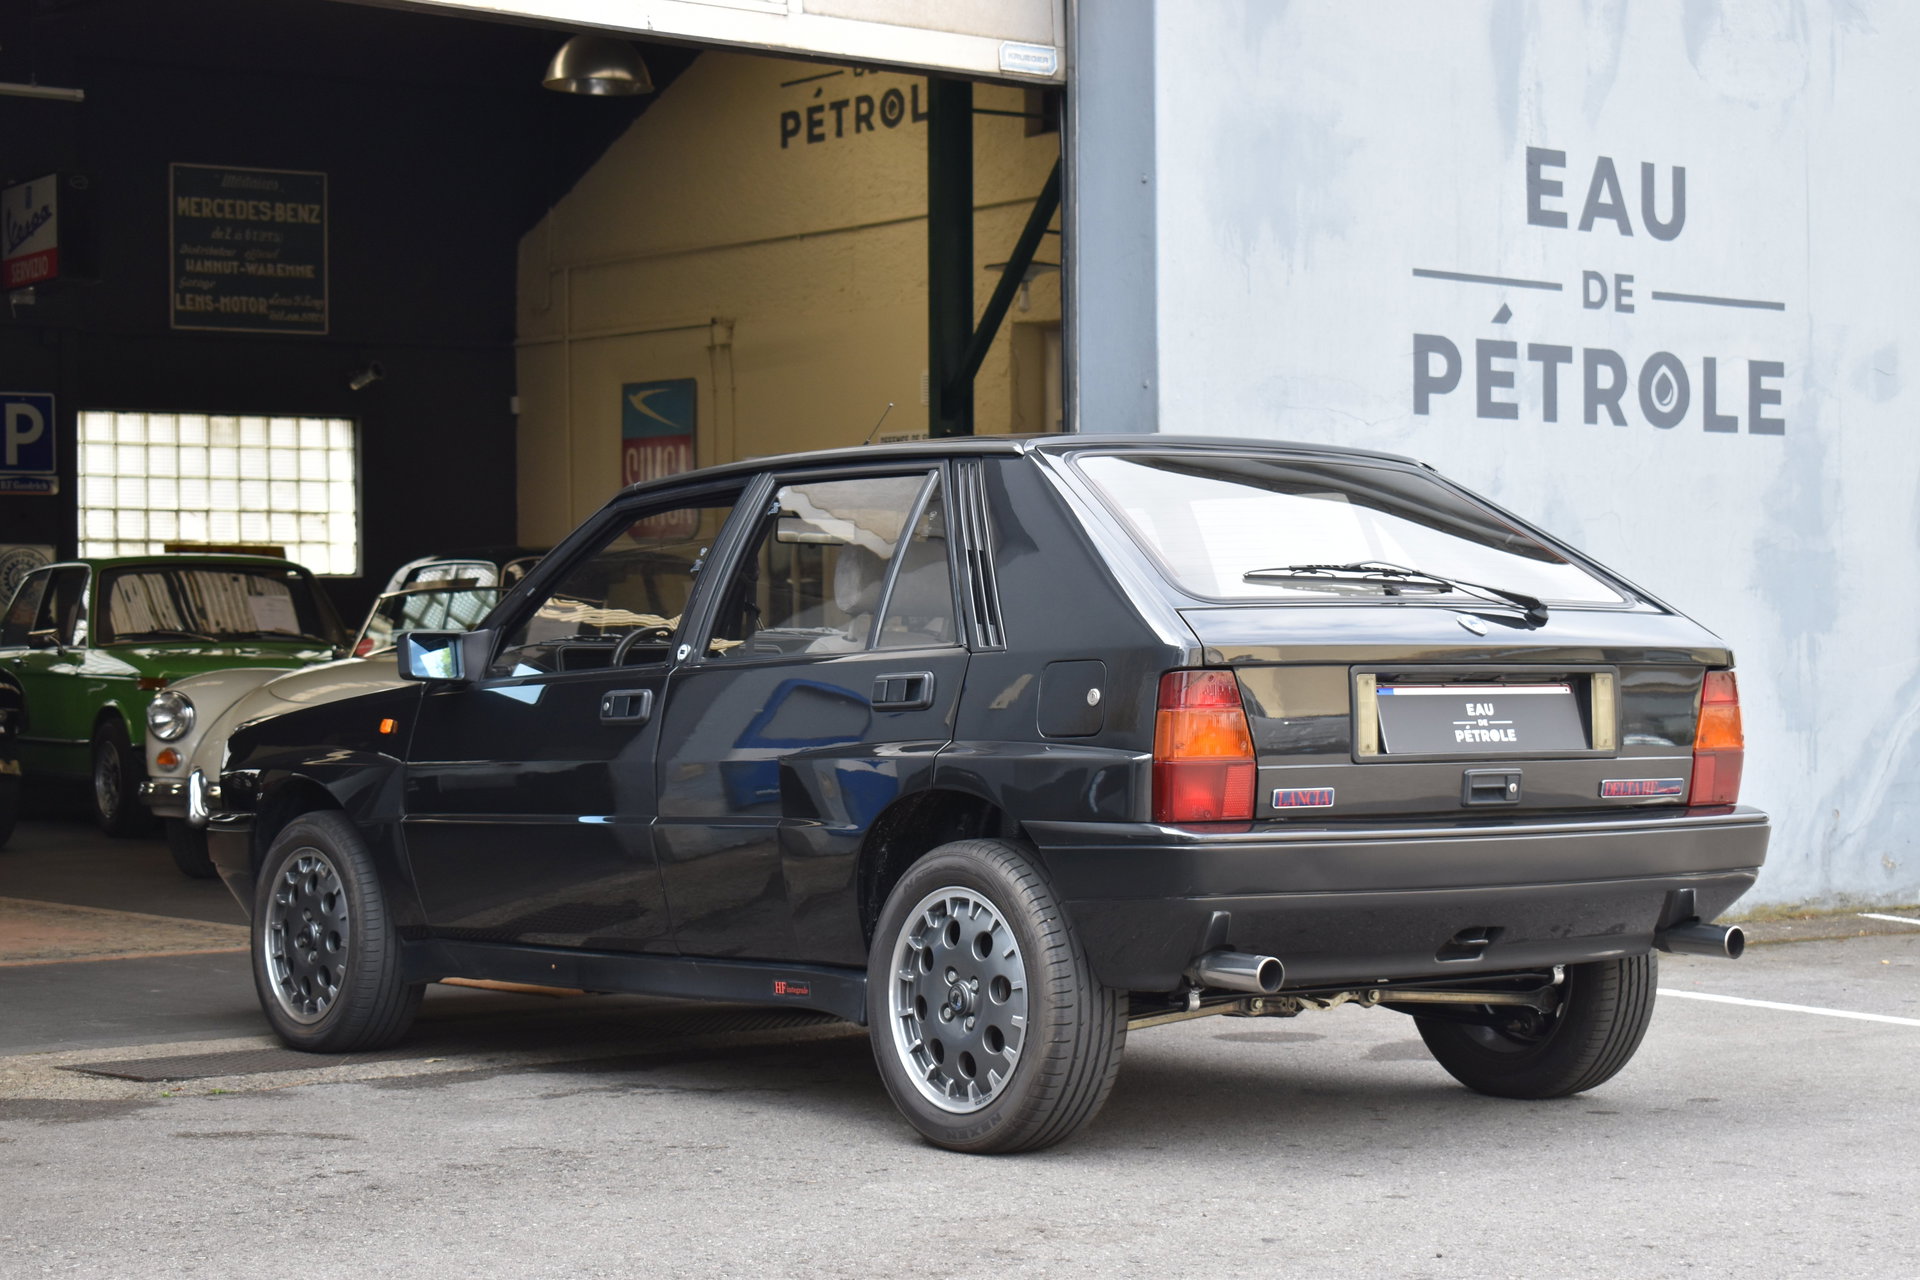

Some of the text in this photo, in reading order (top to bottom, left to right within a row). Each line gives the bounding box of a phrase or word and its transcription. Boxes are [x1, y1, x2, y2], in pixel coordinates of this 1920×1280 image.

[780, 86, 929, 149] PÉTROL
[1526, 145, 1686, 241] EAU
[177, 196, 321, 224] MERCEDES-BENZ
[6, 204, 53, 255] Vespa
[11, 255, 49, 284] SERVIZIO
[1582, 269, 1635, 313] DE
[1413, 302, 1785, 435] PÉTROLE
[5, 403, 44, 466] P
[1466, 703, 1494, 716] EAU
[1477, 719, 1489, 727] DE
[1454, 725, 1517, 742] PÉTROLE
[1277, 790, 1330, 806] LANCIA
[1604, 781, 1640, 796] DELTA
[775, 981, 787, 995] HF
